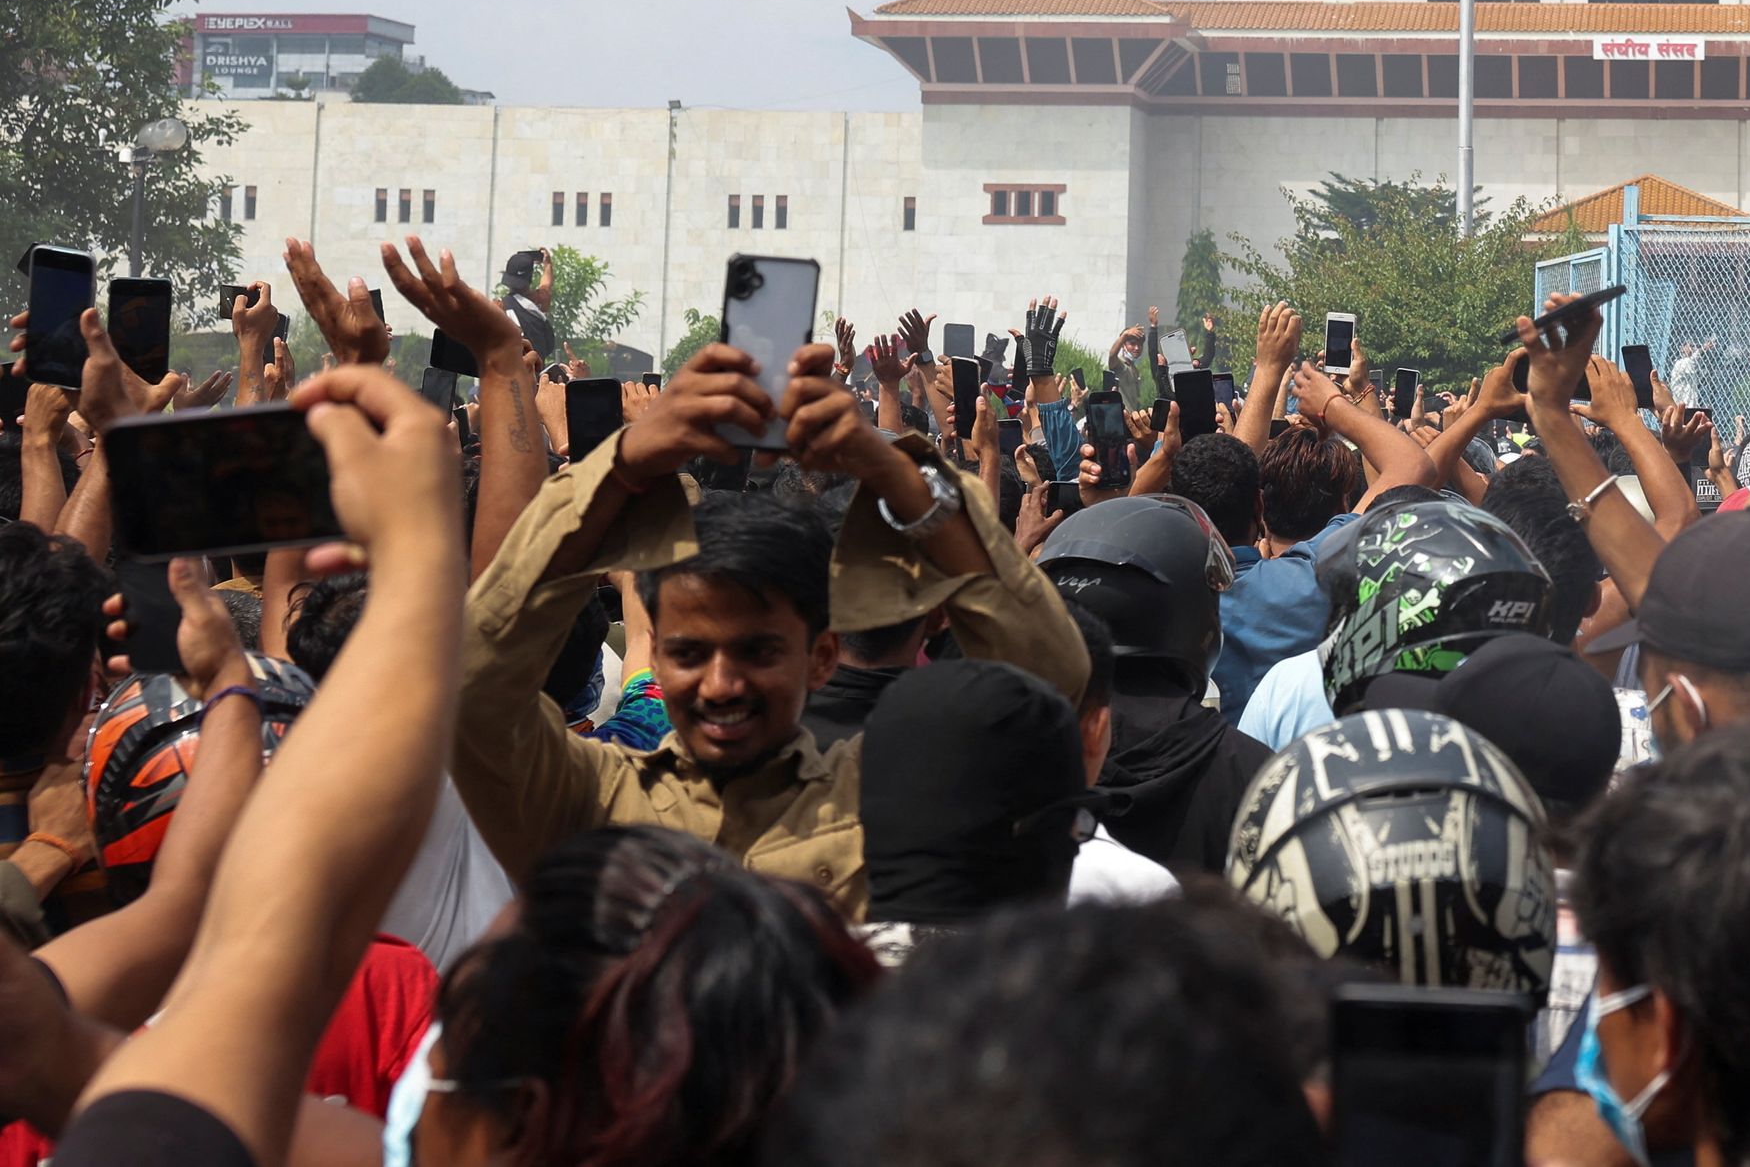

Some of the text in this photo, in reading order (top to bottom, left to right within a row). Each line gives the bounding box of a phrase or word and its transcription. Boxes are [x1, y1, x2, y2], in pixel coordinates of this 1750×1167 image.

[1656, 38, 1698, 58] संसद
[206, 55, 268, 66] DRISHYA
[215, 66, 258, 75] LOUNGE
[1487, 600, 1536, 617] KPI
[1369, 839, 1456, 884] STUDDS
